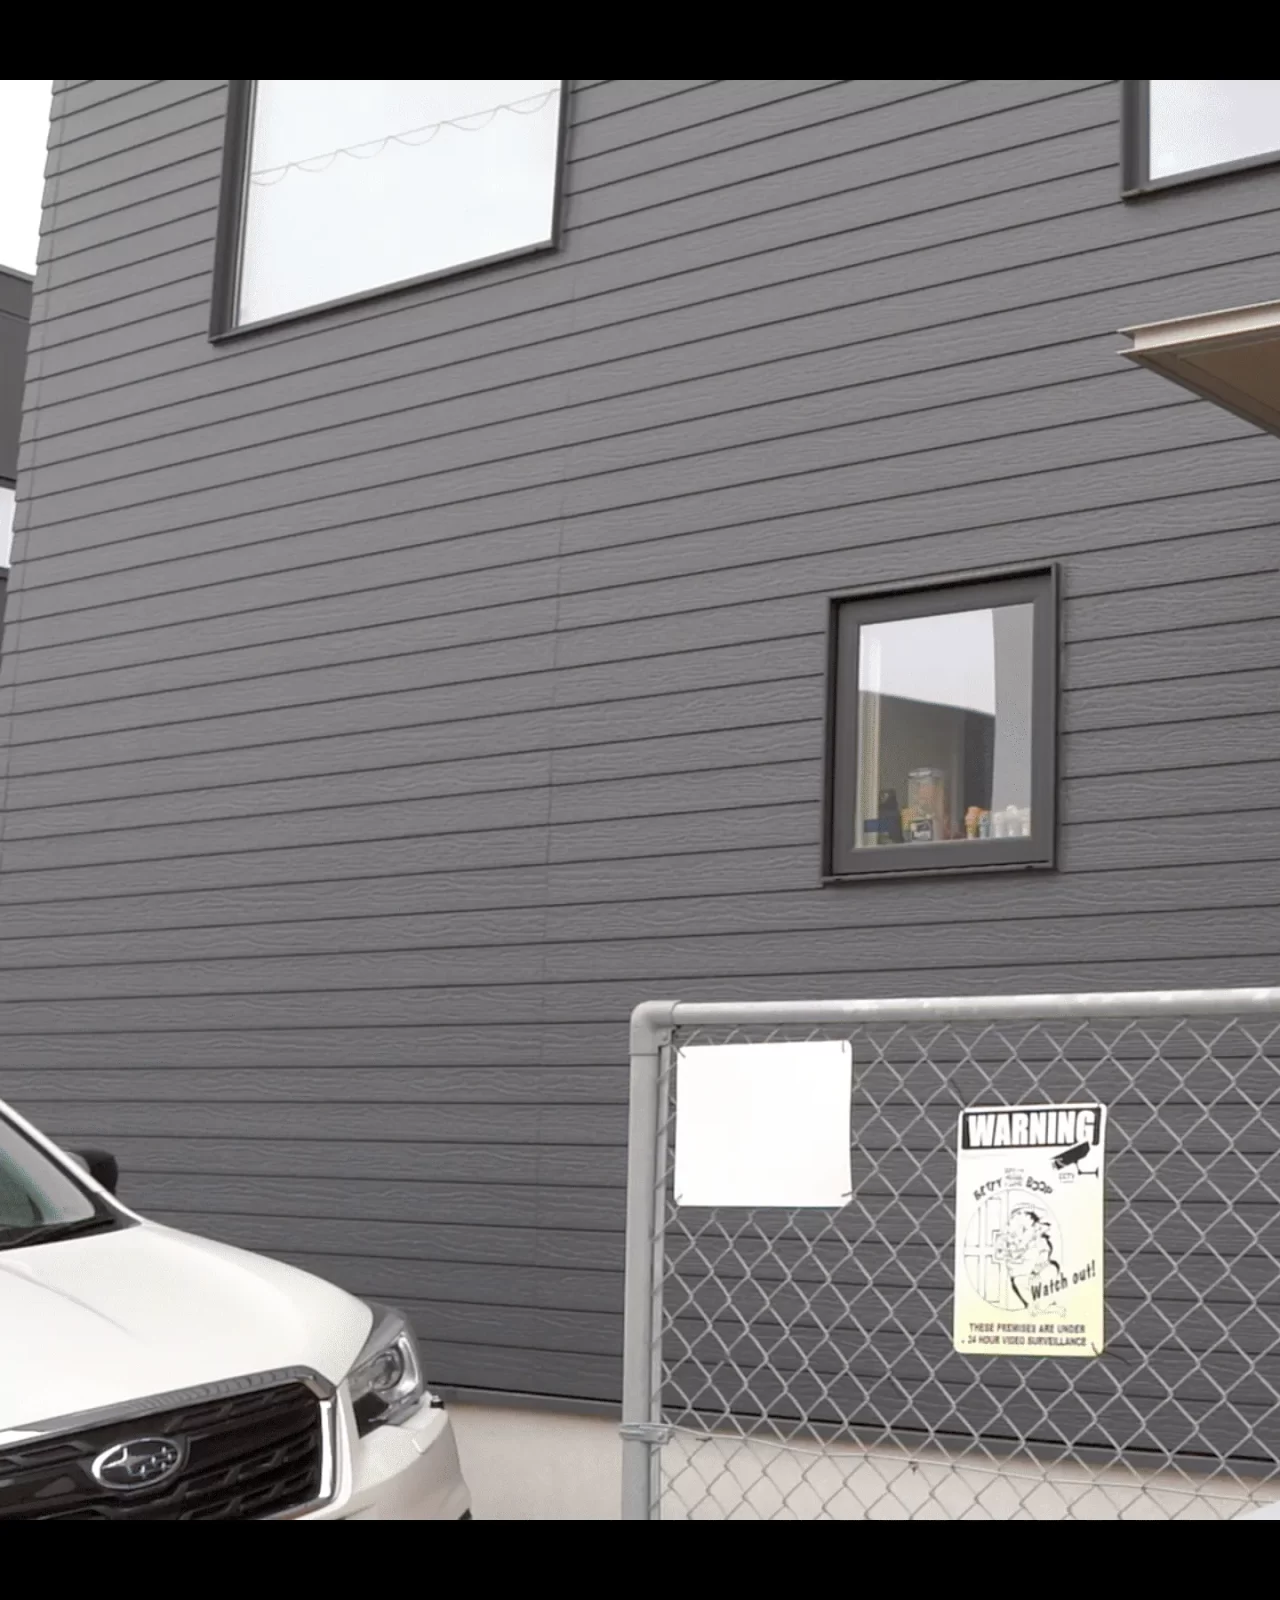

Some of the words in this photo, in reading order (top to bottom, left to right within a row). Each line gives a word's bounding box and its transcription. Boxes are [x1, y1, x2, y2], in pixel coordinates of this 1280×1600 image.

[967, 1110, 1095, 1148] WARNING
[1031, 1269, 1068, 1300] Watch
[1072, 1259, 1096, 1285] out!
[969, 1322, 994, 1333] THESE
[997, 1323, 1036, 1333] PREMISES
[1039, 1323, 1054, 1333] ARE
[1057, 1324, 1085, 1334] UNDER
[979, 1335, 1000, 1345] HOUR
[1002, 1336, 1025, 1345] VIDEO
[1027, 1336, 1086, 1346] SURVEILLANCE
